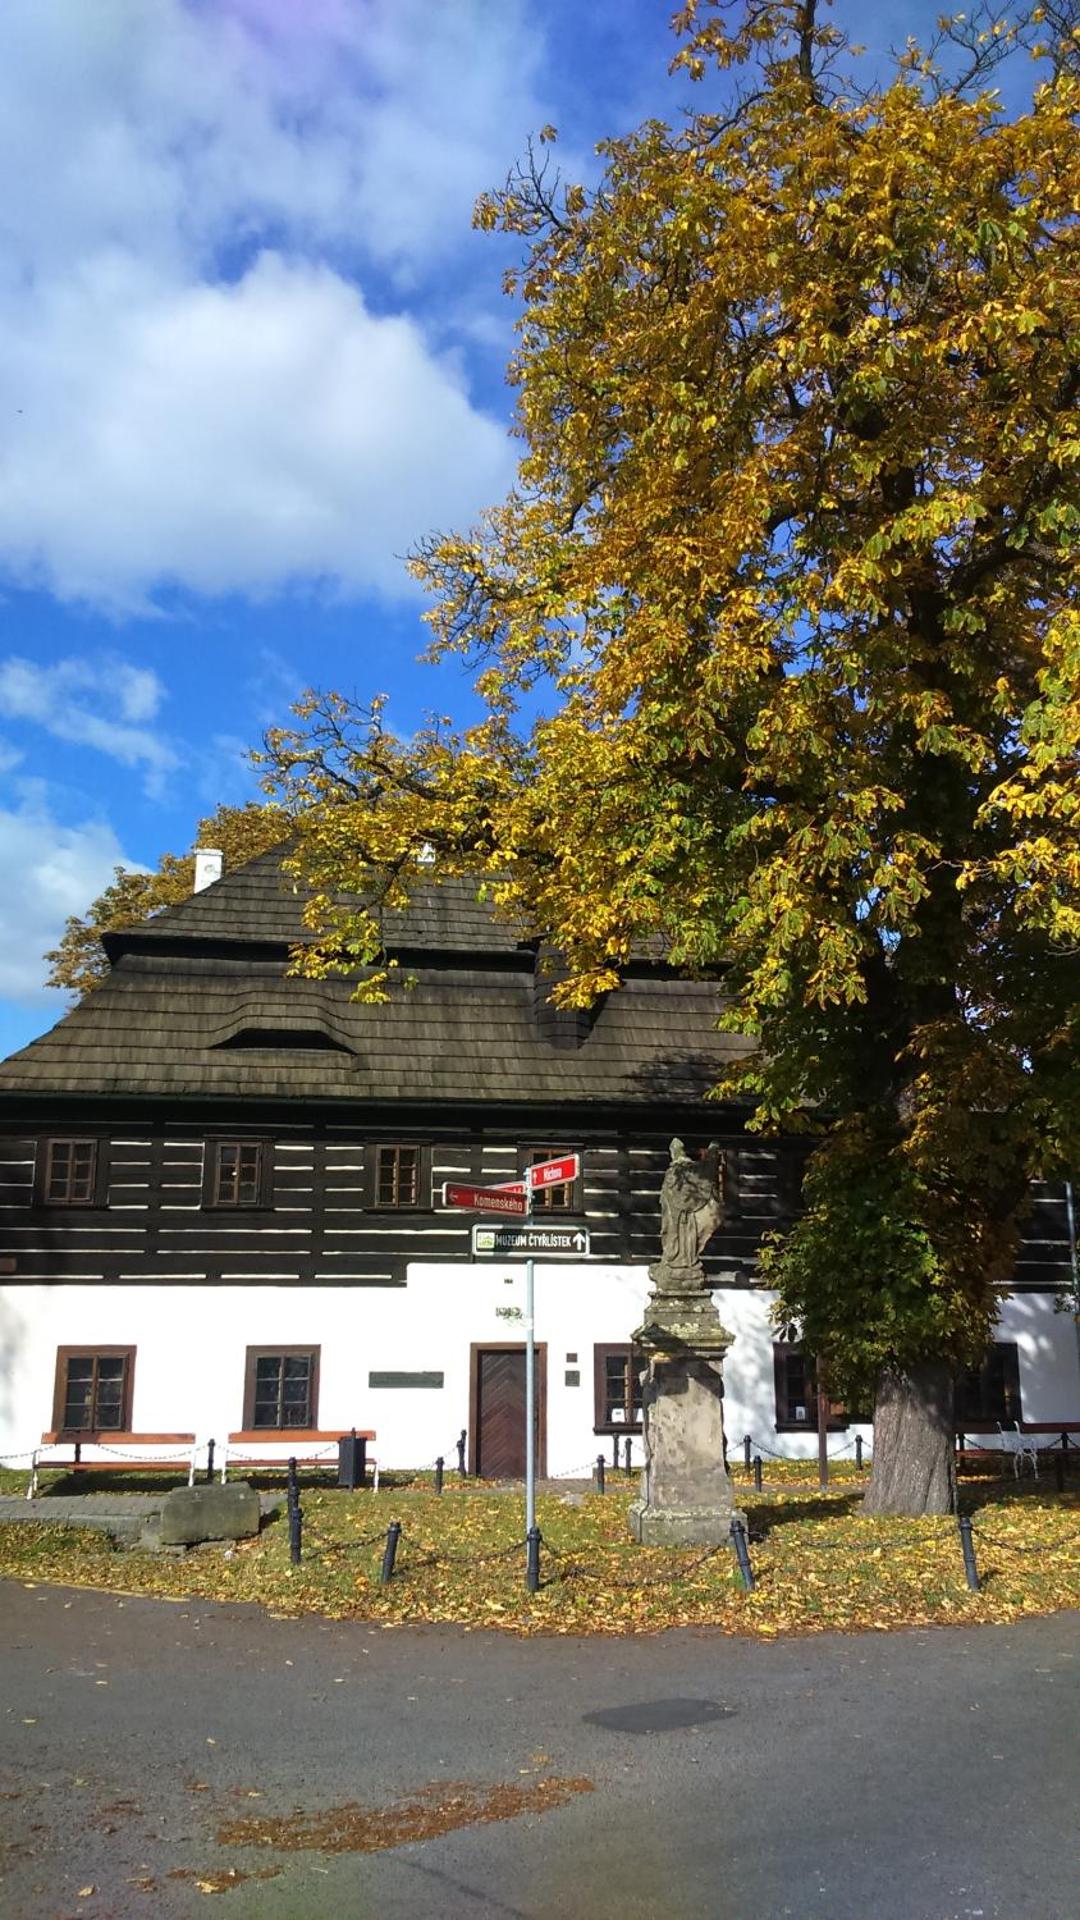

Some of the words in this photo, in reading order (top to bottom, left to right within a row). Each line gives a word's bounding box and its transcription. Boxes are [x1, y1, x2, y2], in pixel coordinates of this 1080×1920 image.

[474, 1193, 523, 1211] Komenského
[495, 1234, 527, 1247] MUZEUM
[528, 1232, 571, 1247] ČTYŘLÍSTEK
